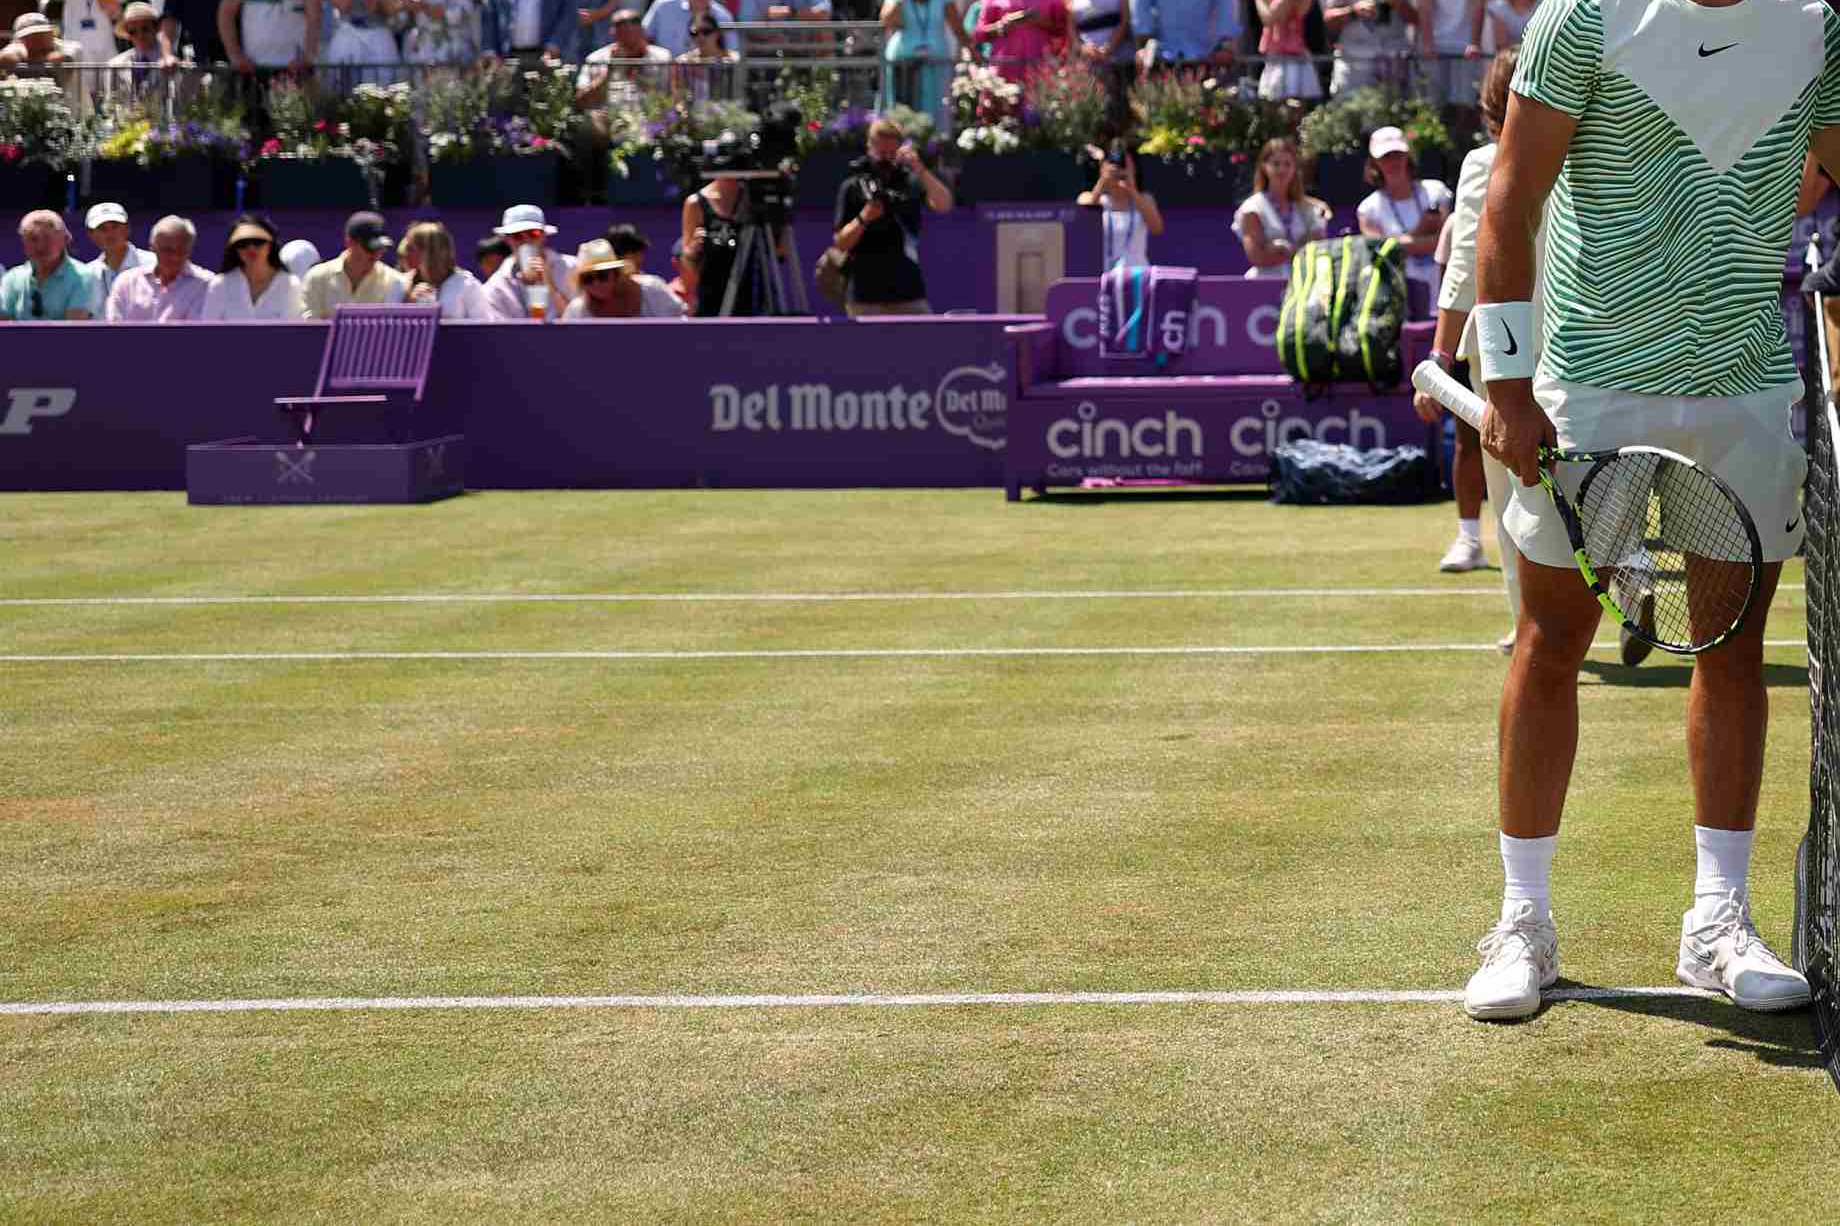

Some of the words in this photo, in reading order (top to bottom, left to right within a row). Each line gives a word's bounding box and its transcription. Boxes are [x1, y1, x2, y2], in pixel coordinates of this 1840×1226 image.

[709, 384, 783, 431] Del
[788, 383, 932, 431] Monte
[1046, 401, 1204, 458] cinch
